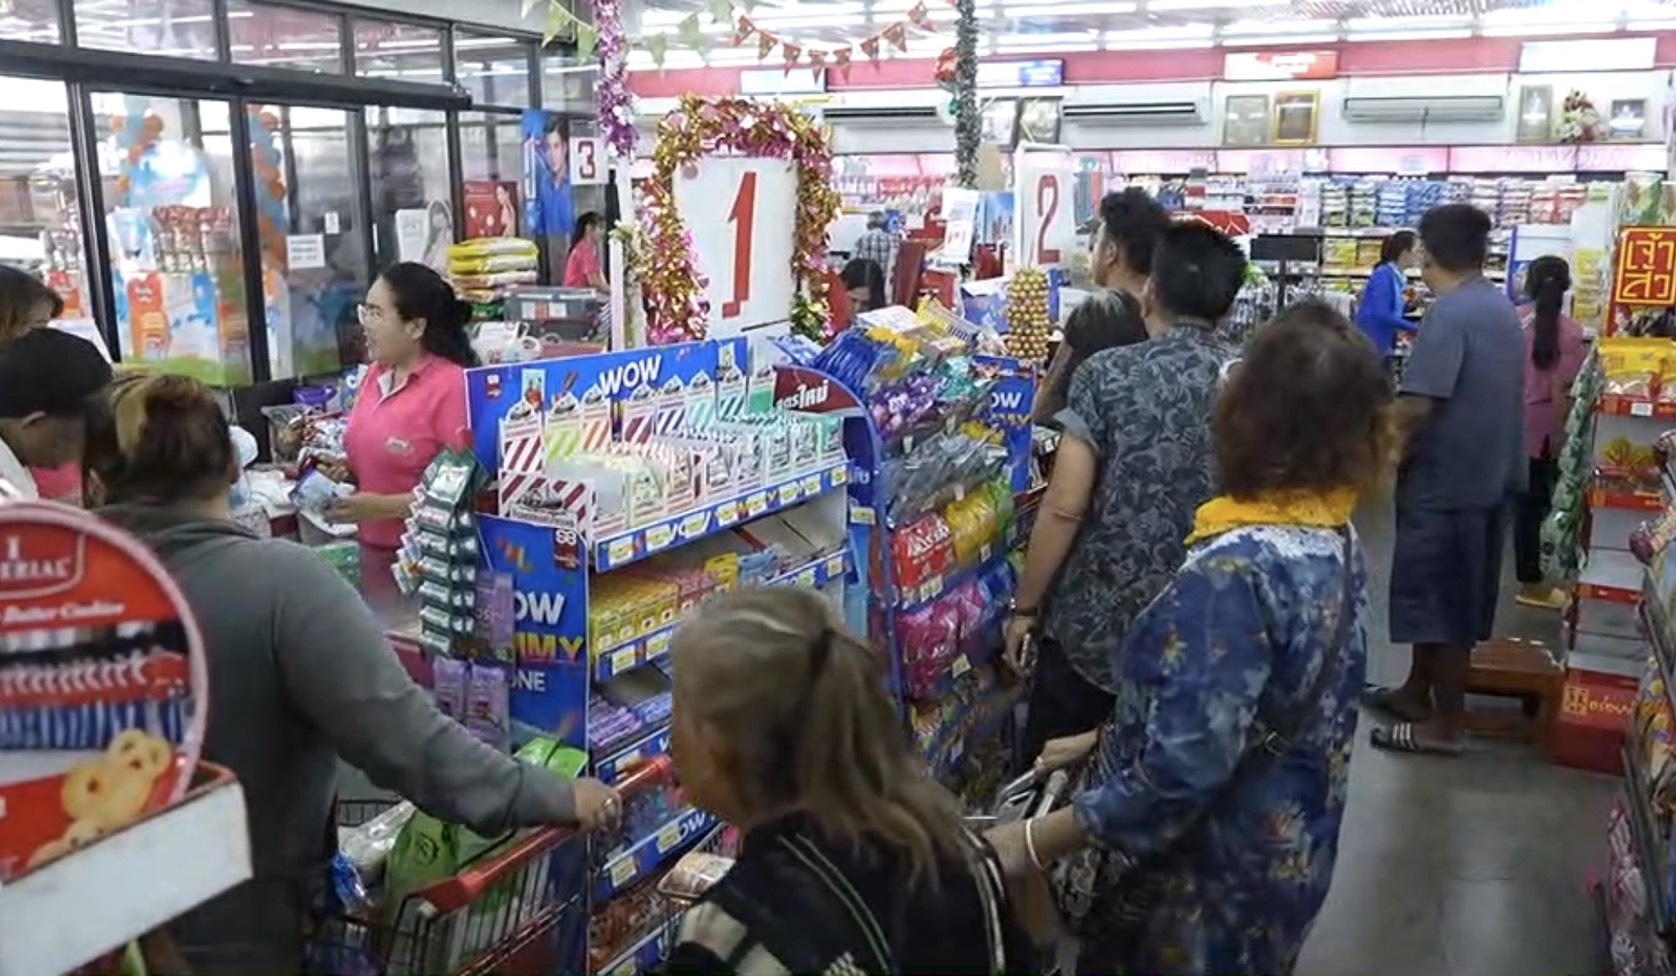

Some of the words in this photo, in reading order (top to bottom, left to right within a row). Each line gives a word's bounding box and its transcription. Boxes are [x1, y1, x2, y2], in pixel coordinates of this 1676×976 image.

[578, 140, 595, 179] 3
[1038, 174, 1060, 264] 2
[722, 172, 757, 318] 1
[600, 355, 662, 395] WOW
[991, 392, 1022, 409] OW
[0, 557, 70, 580] ERIAL
[514, 590, 565, 625] OW
[511, 669, 546, 692] NE
